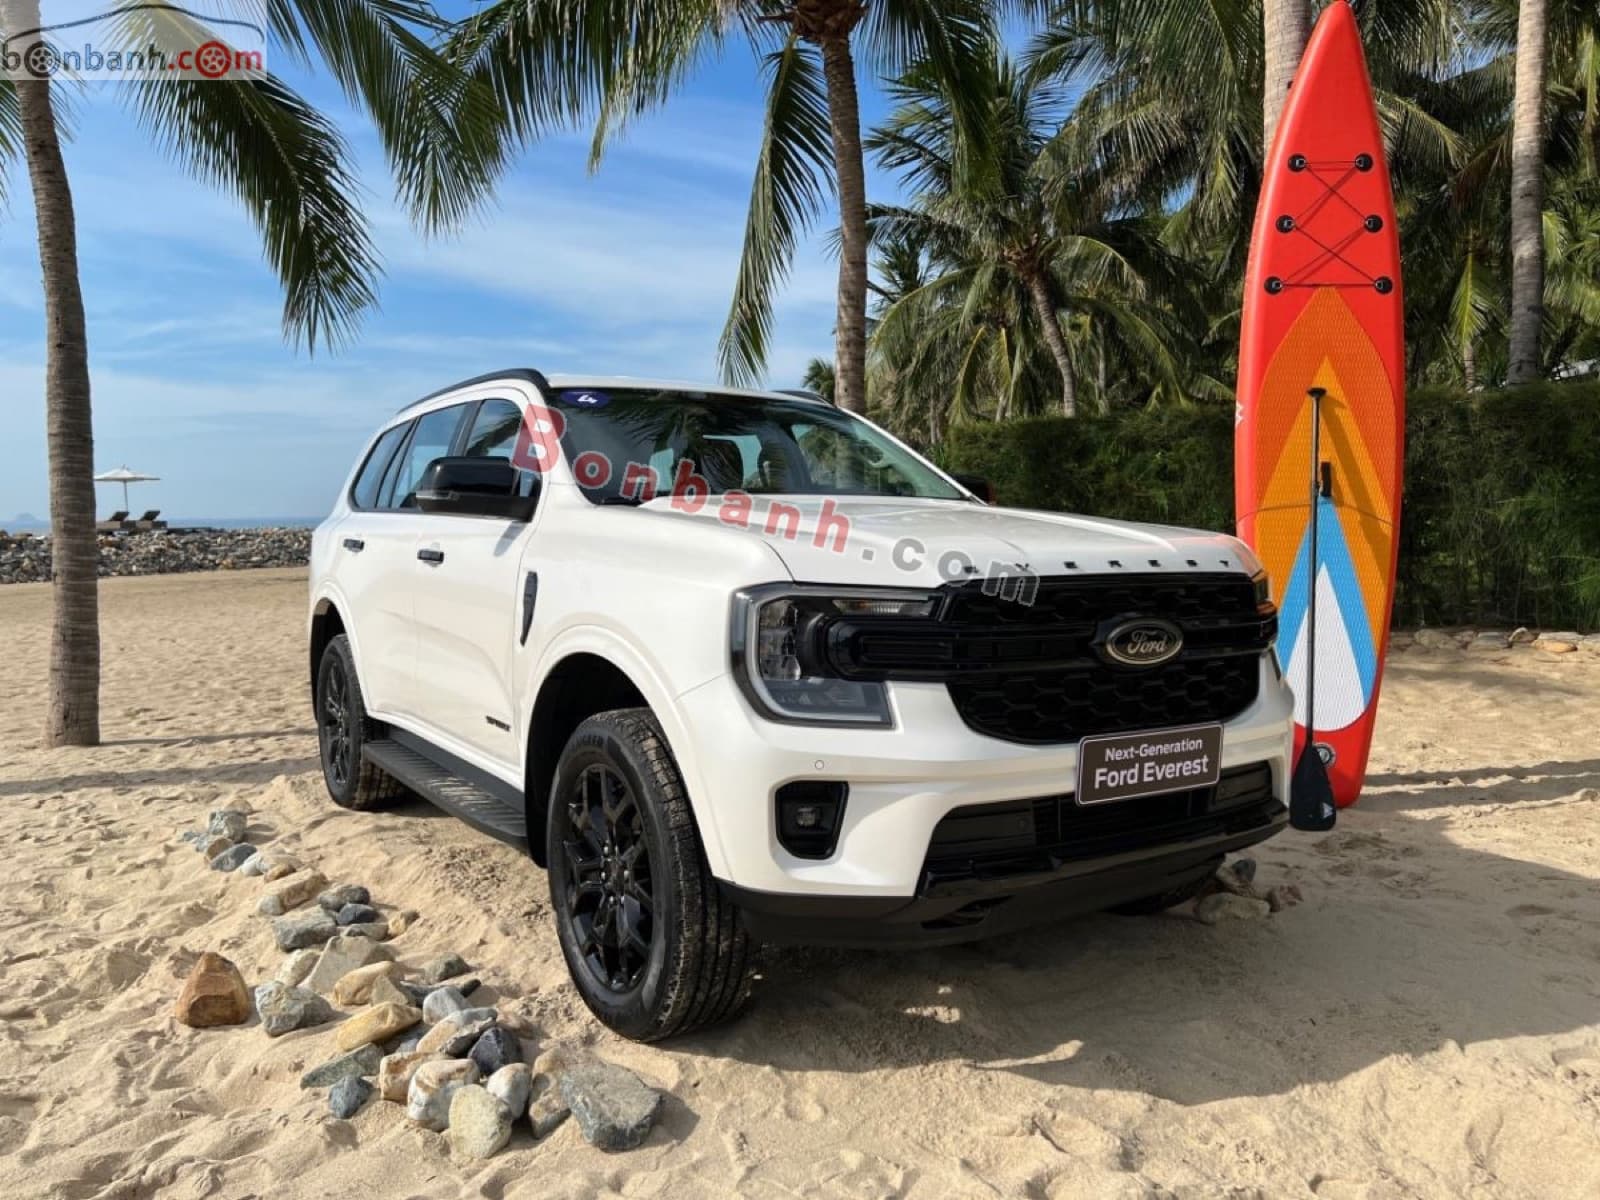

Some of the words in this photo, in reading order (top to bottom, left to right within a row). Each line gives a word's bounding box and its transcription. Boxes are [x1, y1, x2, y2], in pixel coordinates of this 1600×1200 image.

[1127, 629, 1167, 654] Ford
[1104, 738, 1203, 762] Next-Generation
[1094, 763, 1139, 789] Ford
[1143, 754, 1209, 783] Everest
